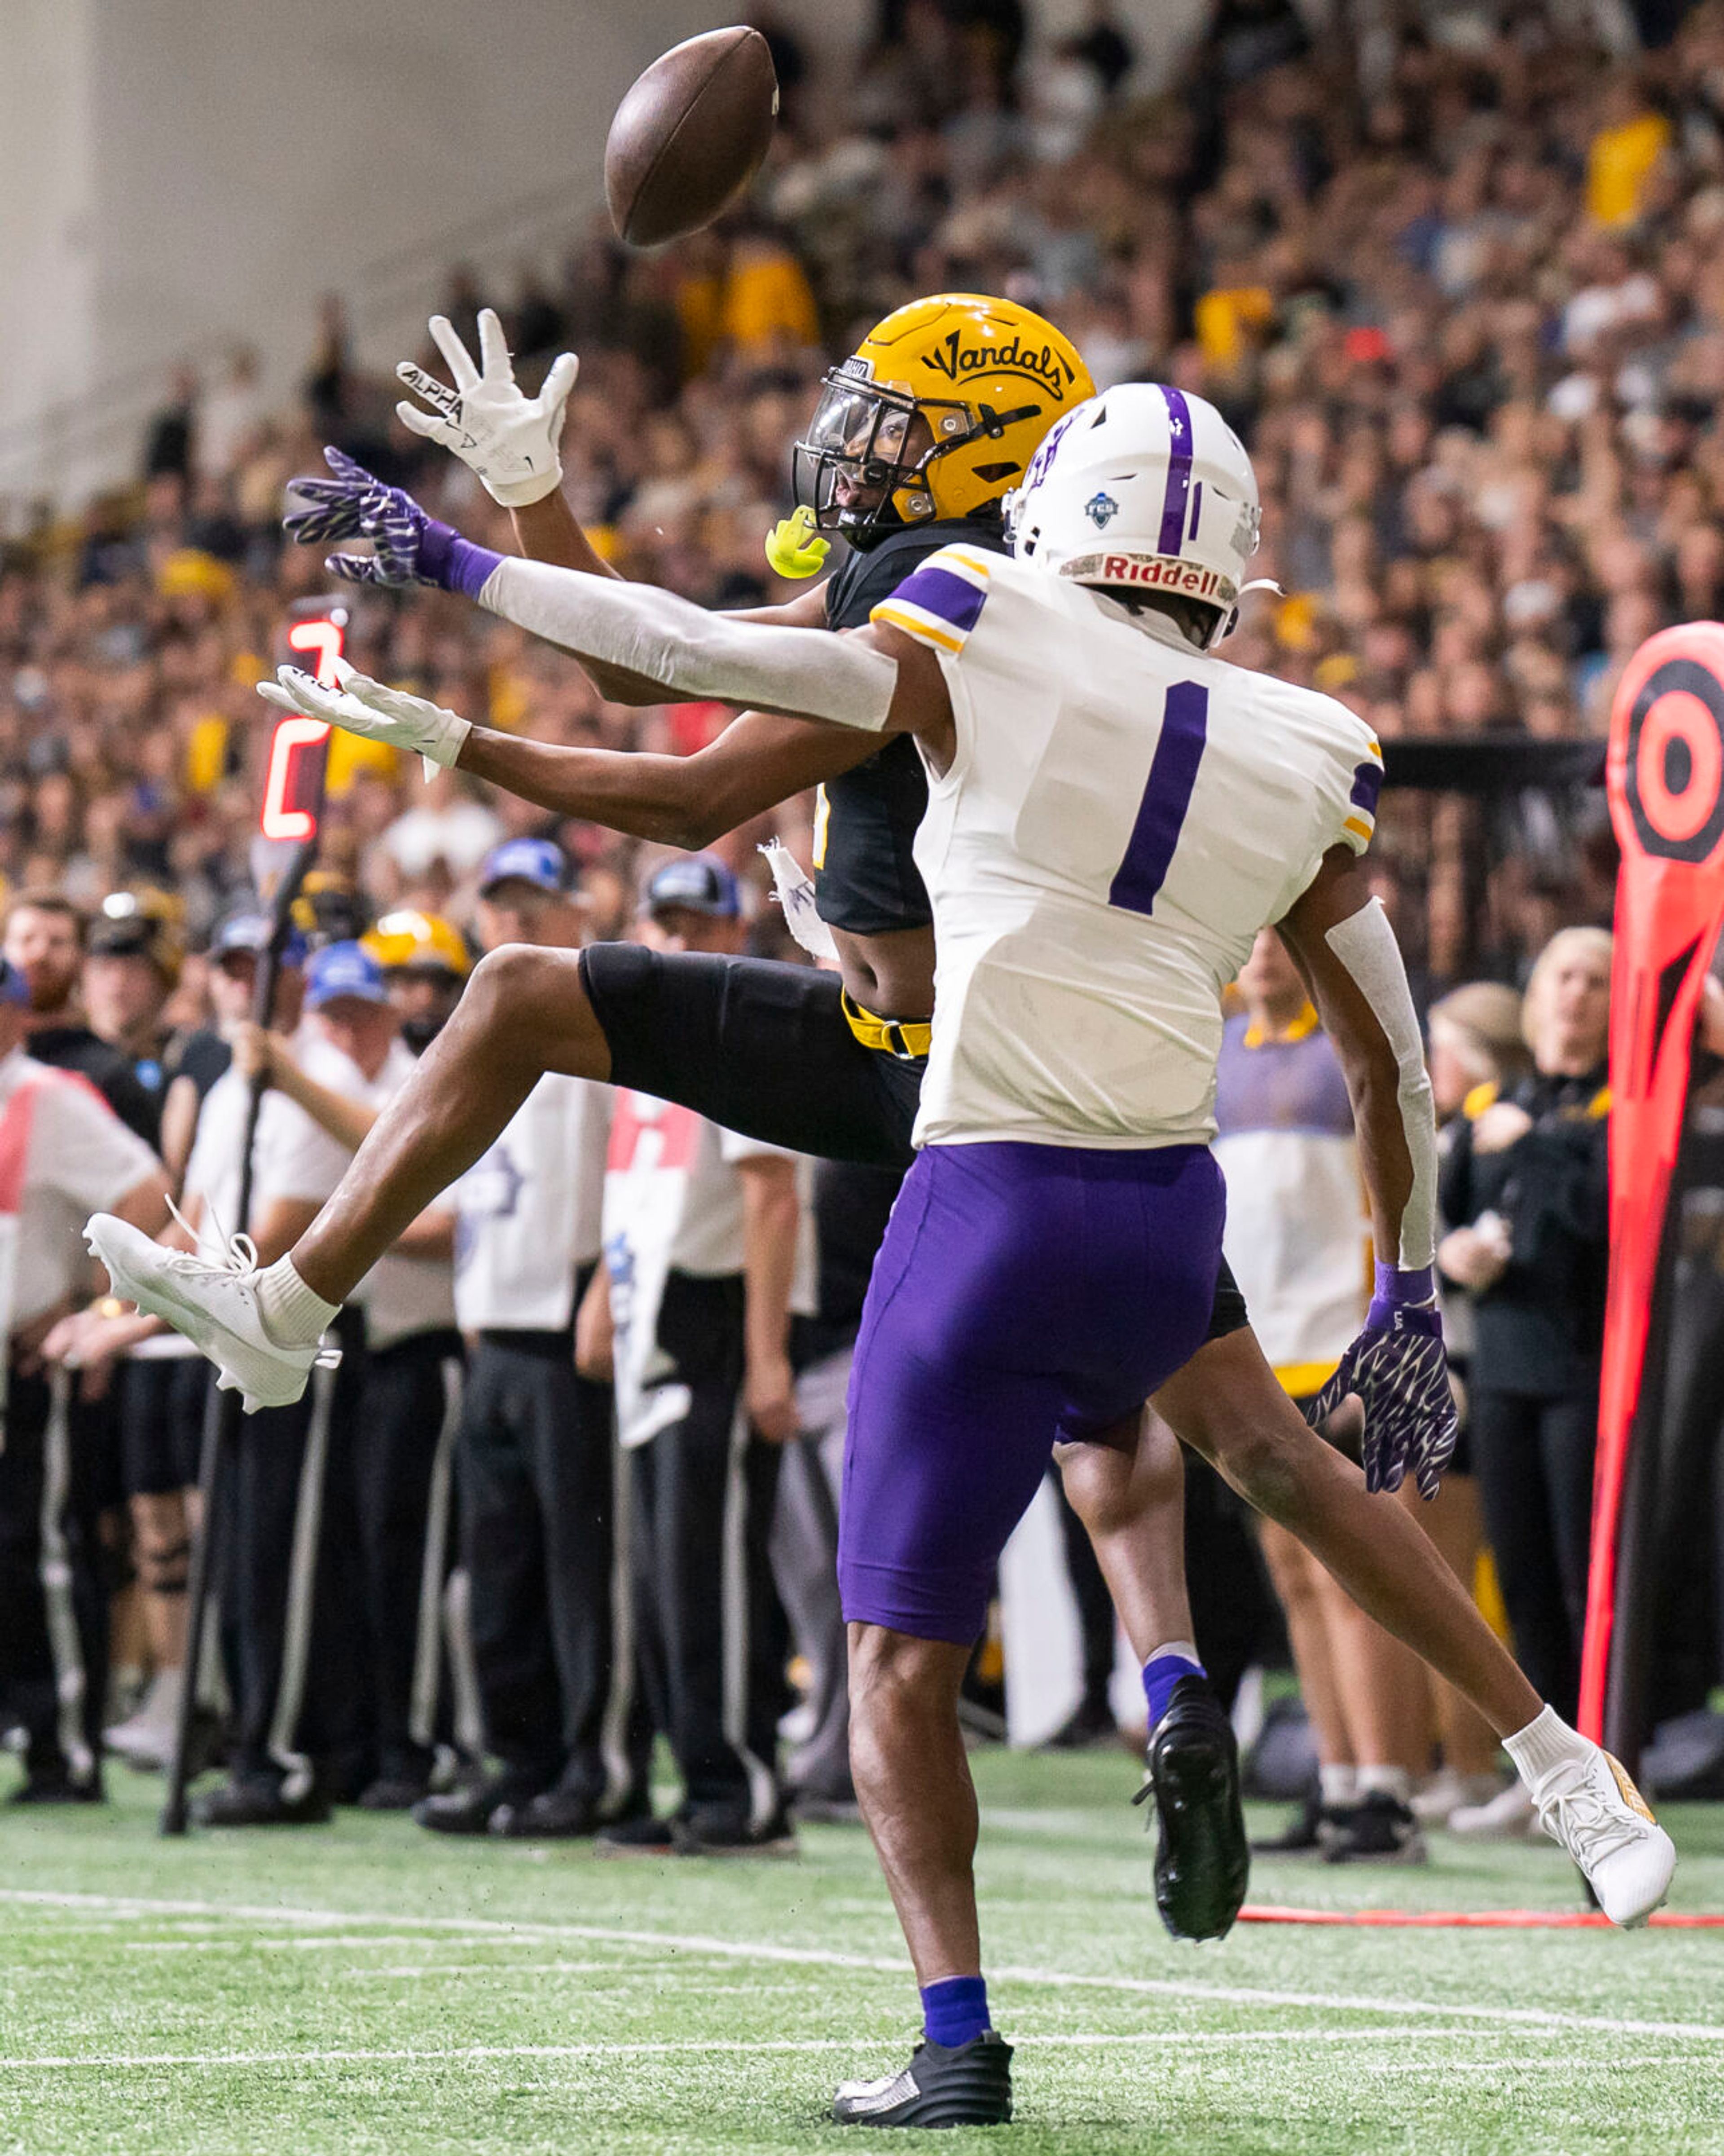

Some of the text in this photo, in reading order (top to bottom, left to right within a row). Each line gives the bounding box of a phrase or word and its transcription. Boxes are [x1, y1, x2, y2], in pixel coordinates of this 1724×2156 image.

[921, 329, 1063, 401] Vandals
[402, 370, 463, 425] ALPHA
[1104, 556, 1218, 596] Riddell
[1108, 680, 1209, 916] 1
